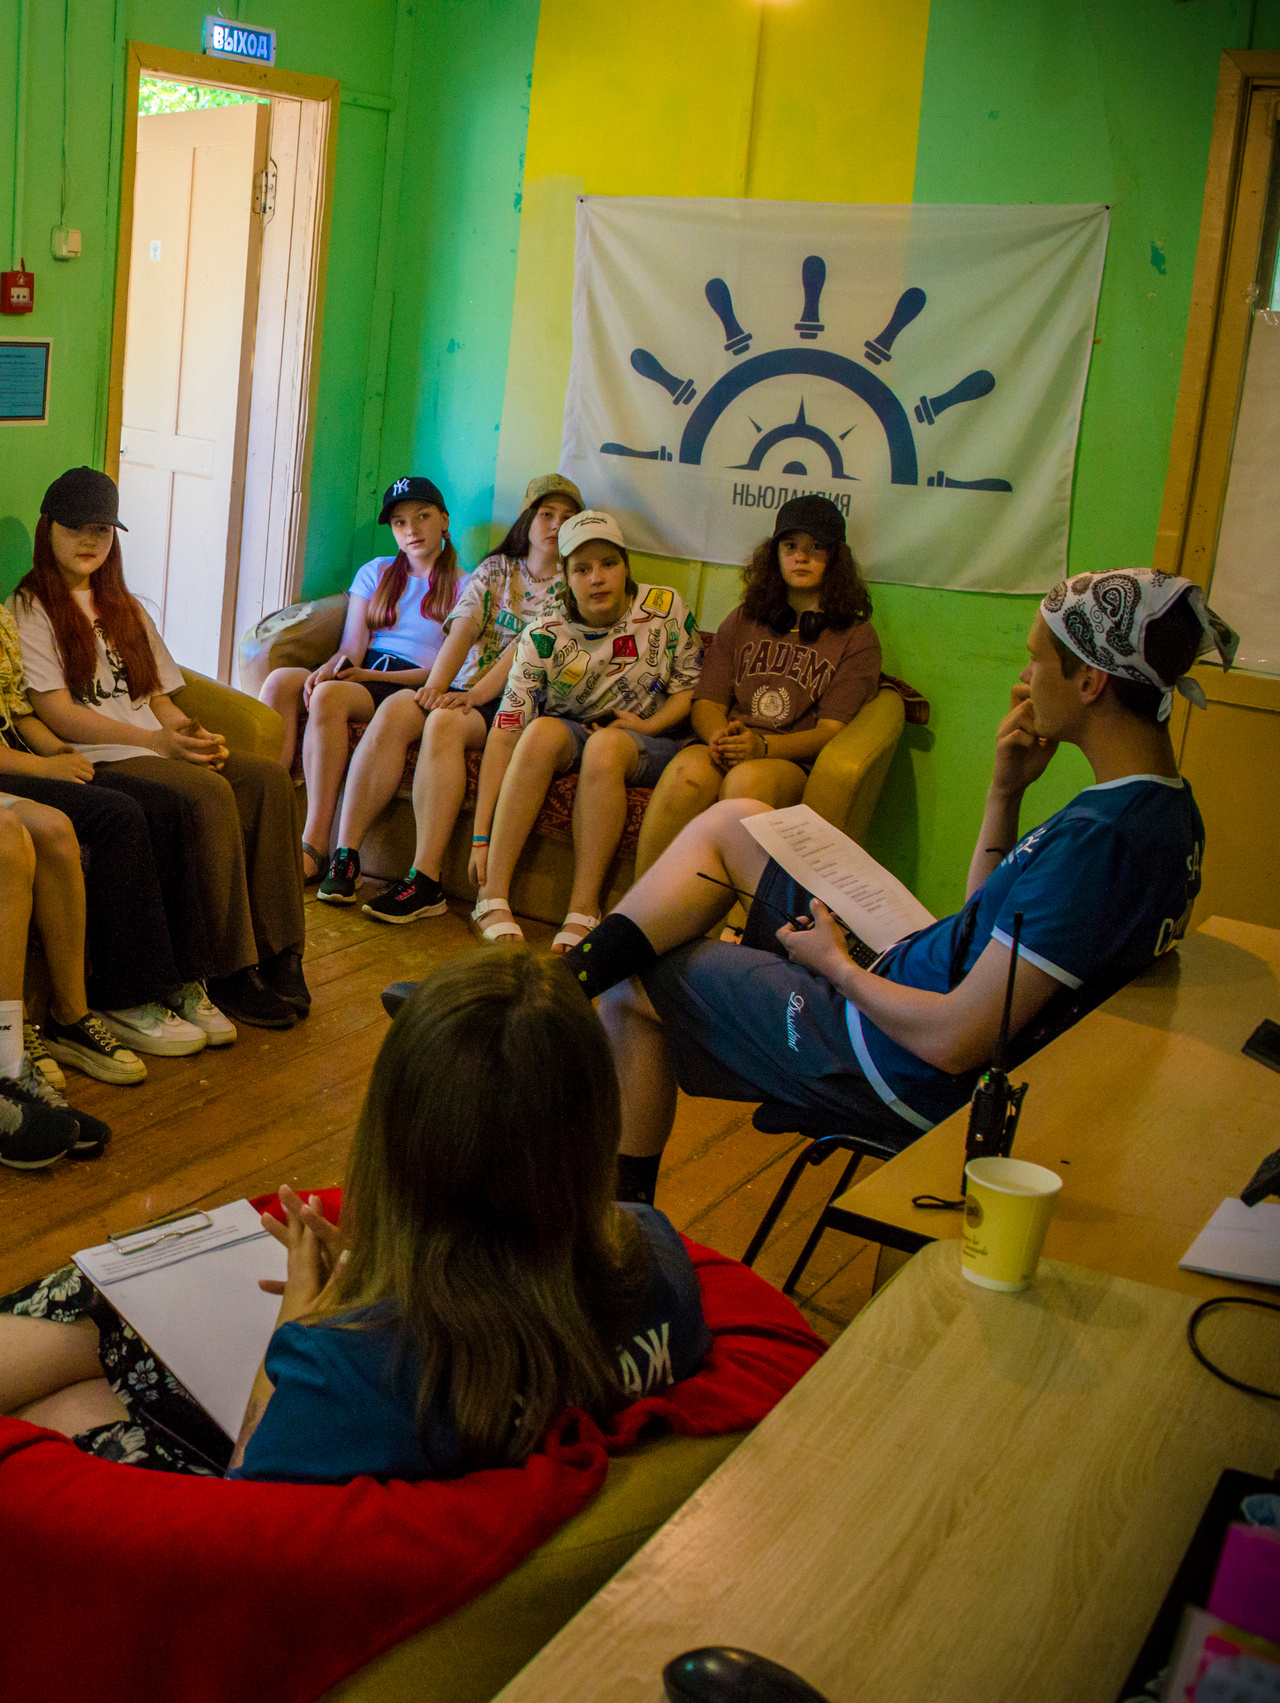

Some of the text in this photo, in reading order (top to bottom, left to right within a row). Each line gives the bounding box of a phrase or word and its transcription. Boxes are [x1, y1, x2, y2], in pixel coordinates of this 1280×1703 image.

[213, 25, 268, 58] ВЫХОД
[393, 477, 410, 496] NY
[734, 639, 837, 702] CADEM
